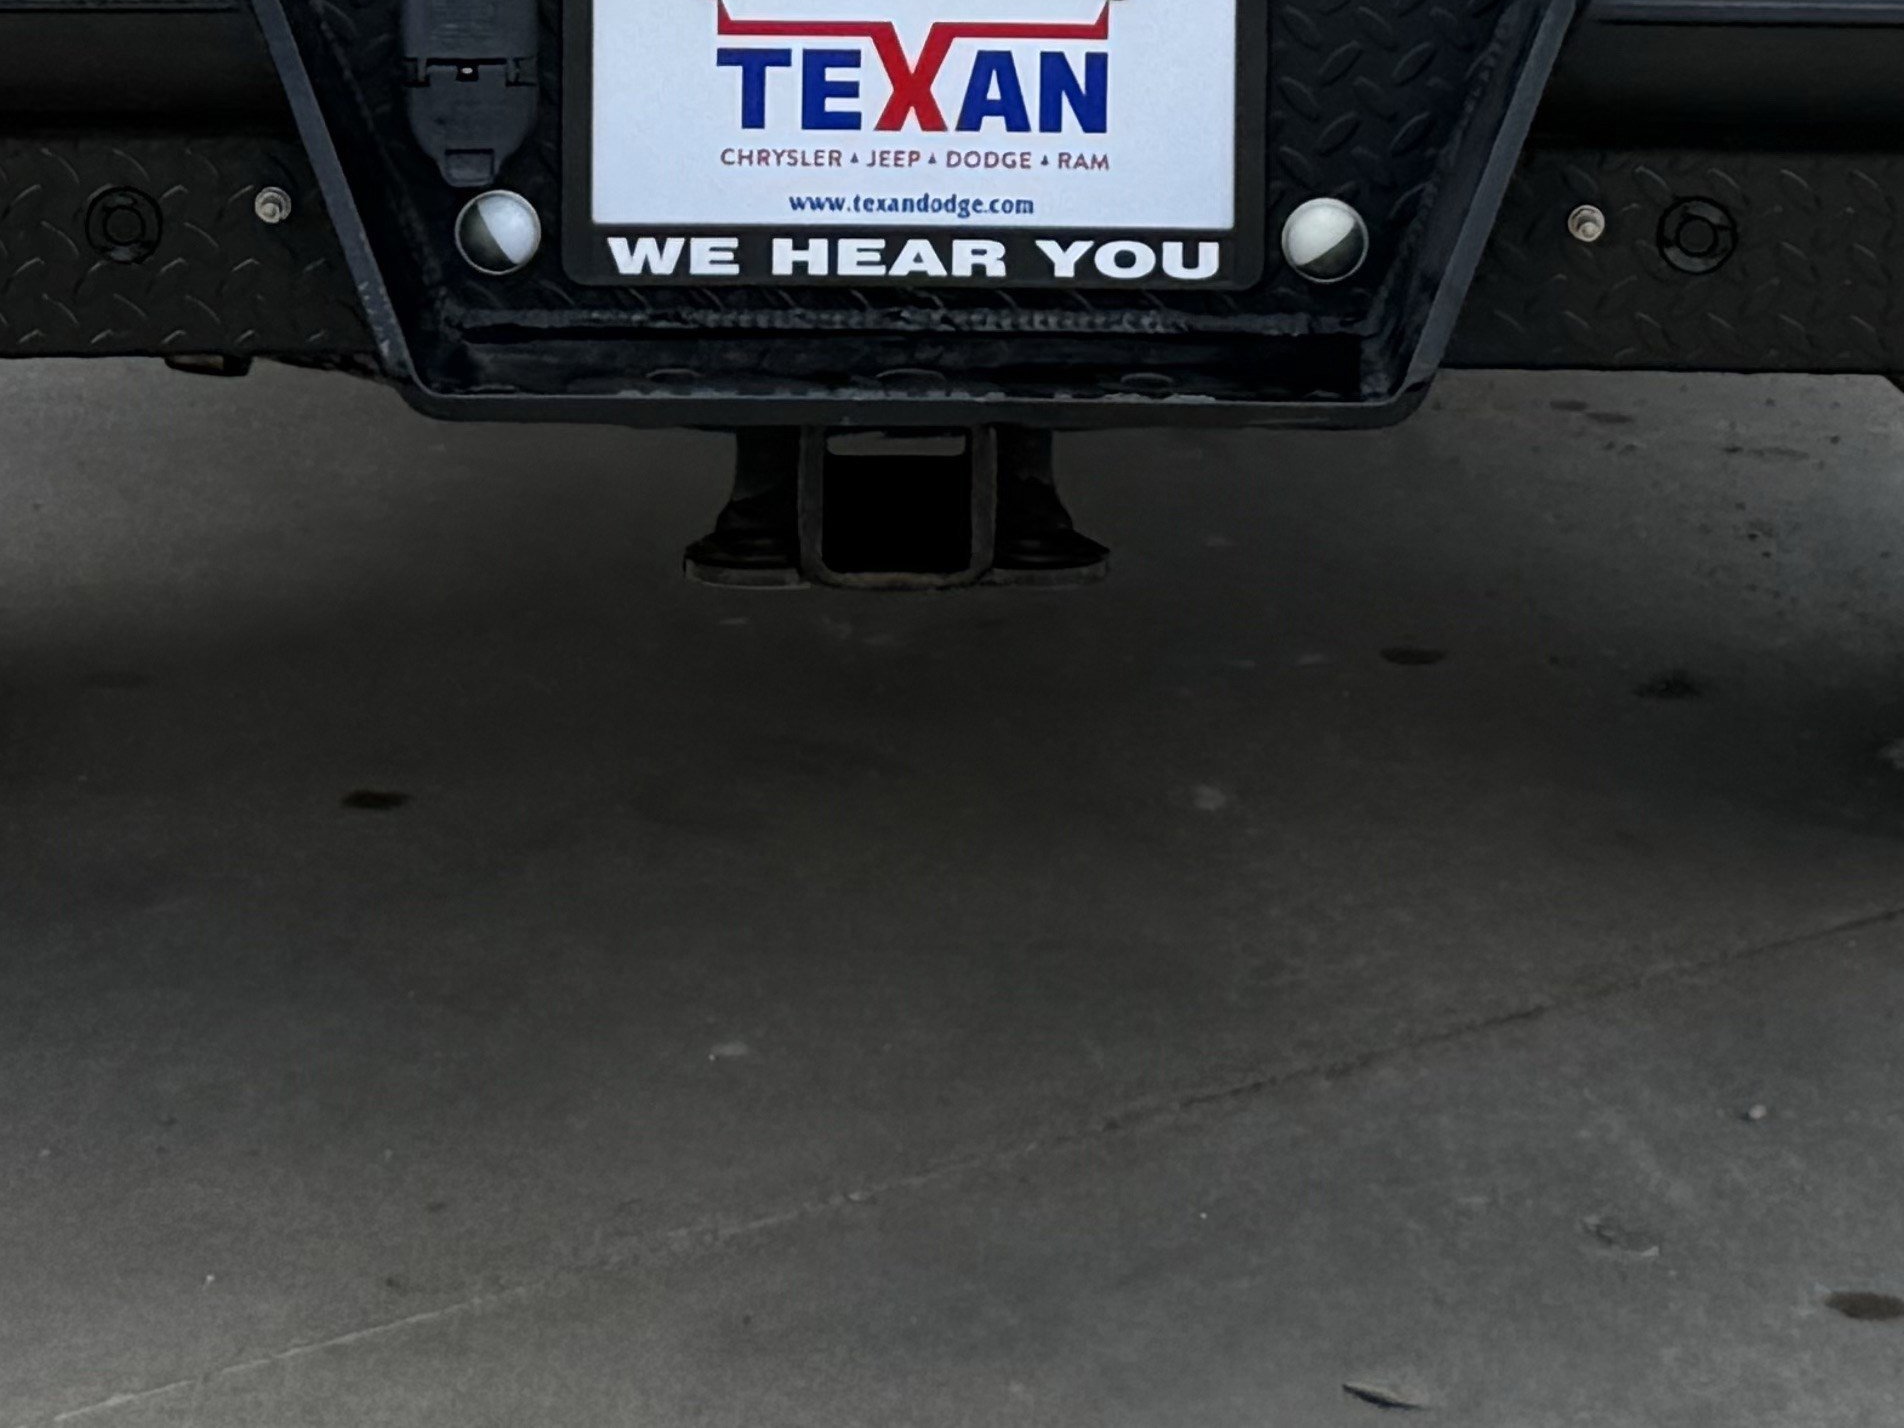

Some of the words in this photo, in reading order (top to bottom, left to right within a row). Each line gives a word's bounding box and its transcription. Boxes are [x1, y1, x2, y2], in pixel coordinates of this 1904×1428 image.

[716, 16, 1109, 134] TEXAN
[720, 147, 843, 169] CHRYSLER
[866, 149, 921, 169] JEEP
[945, 150, 1032, 170] DODGE
[1057, 152, 1110, 171] RAM
[788, 193, 1035, 219] www.texandodge.com
[607, 236, 740, 276] WE
[771, 237, 1007, 278] HEAR
[1035, 239, 1221, 280] YOU
